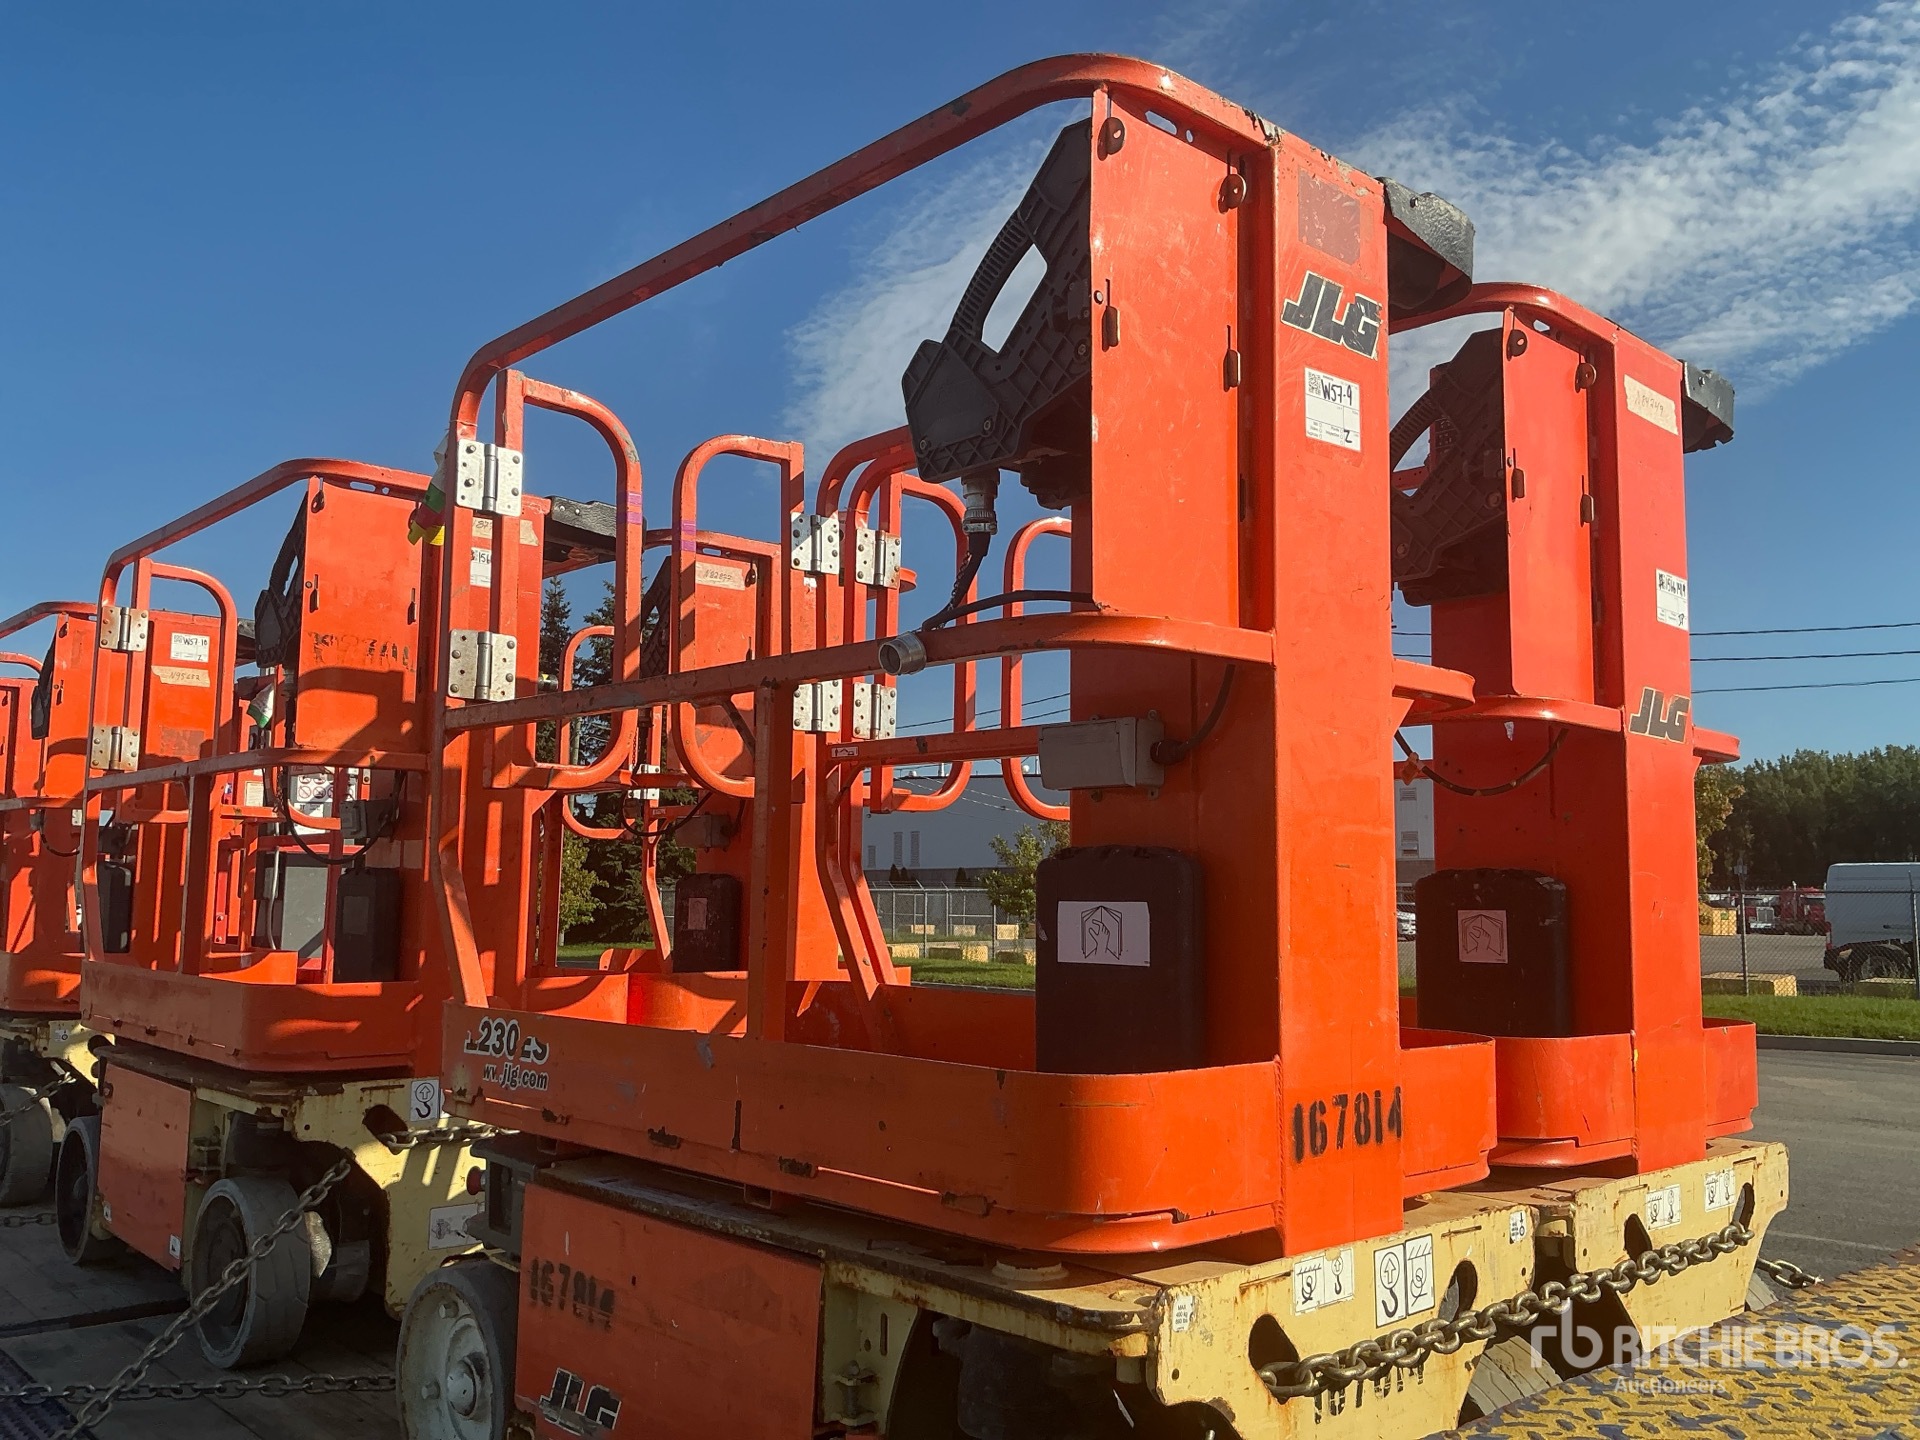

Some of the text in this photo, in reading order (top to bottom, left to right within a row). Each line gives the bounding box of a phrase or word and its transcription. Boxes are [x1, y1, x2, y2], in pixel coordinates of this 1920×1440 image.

[1281, 270, 1383, 360] JLG
[1321, 379, 1353, 406] W57-9
[1628, 686, 1691, 744] JLG
[1292, 1086, 1403, 1164] 167814
[539, 1367, 622, 1437] JLG
